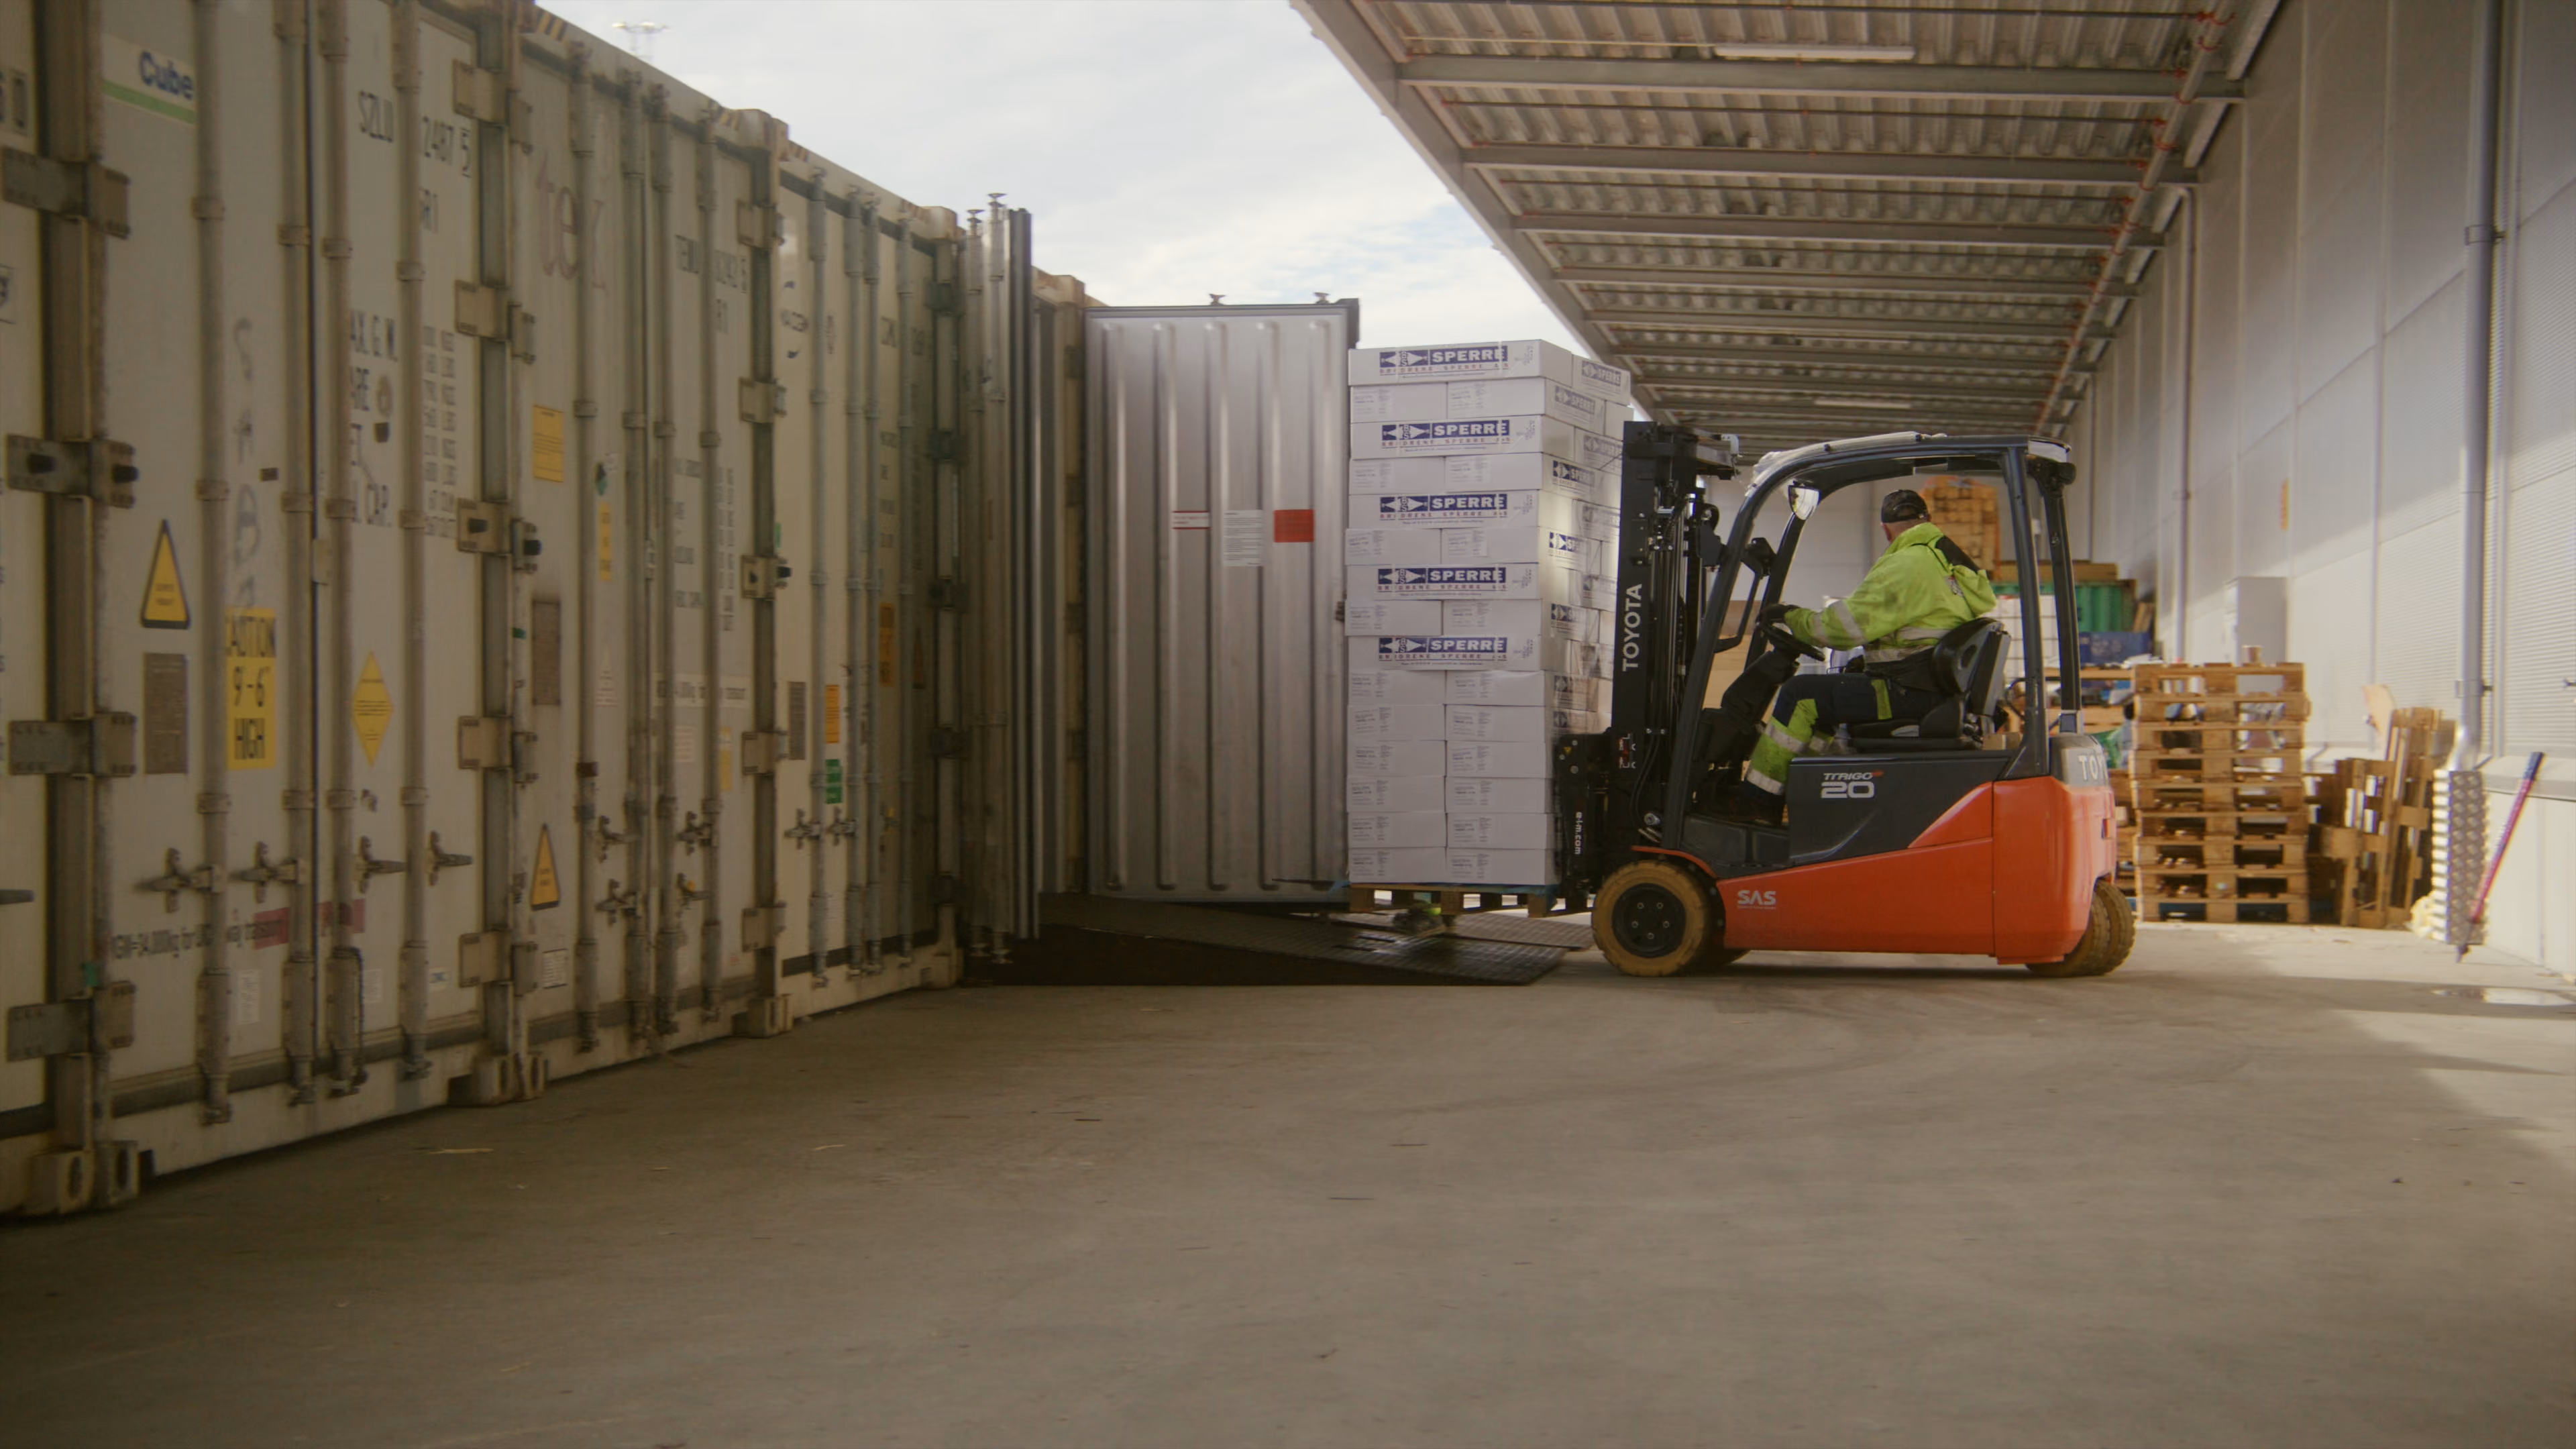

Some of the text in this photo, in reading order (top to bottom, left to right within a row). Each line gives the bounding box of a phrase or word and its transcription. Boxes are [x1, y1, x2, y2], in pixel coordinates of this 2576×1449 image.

[139, 50, 195, 101] Cube
[358, 90, 394, 143] SZLU
[1432, 349, 1505, 363] SPERRE
[1434, 423, 1507, 436] SPERRE
[1432, 496, 1504, 508] SPERRE
[1430, 570, 1503, 581] SPERRE
[1621, 584, 1643, 672] TOYOTA
[1431, 640, 1503, 651] SPERRE
[1821, 781, 1875, 798] 20
[1737, 890, 1777, 906] SAS
